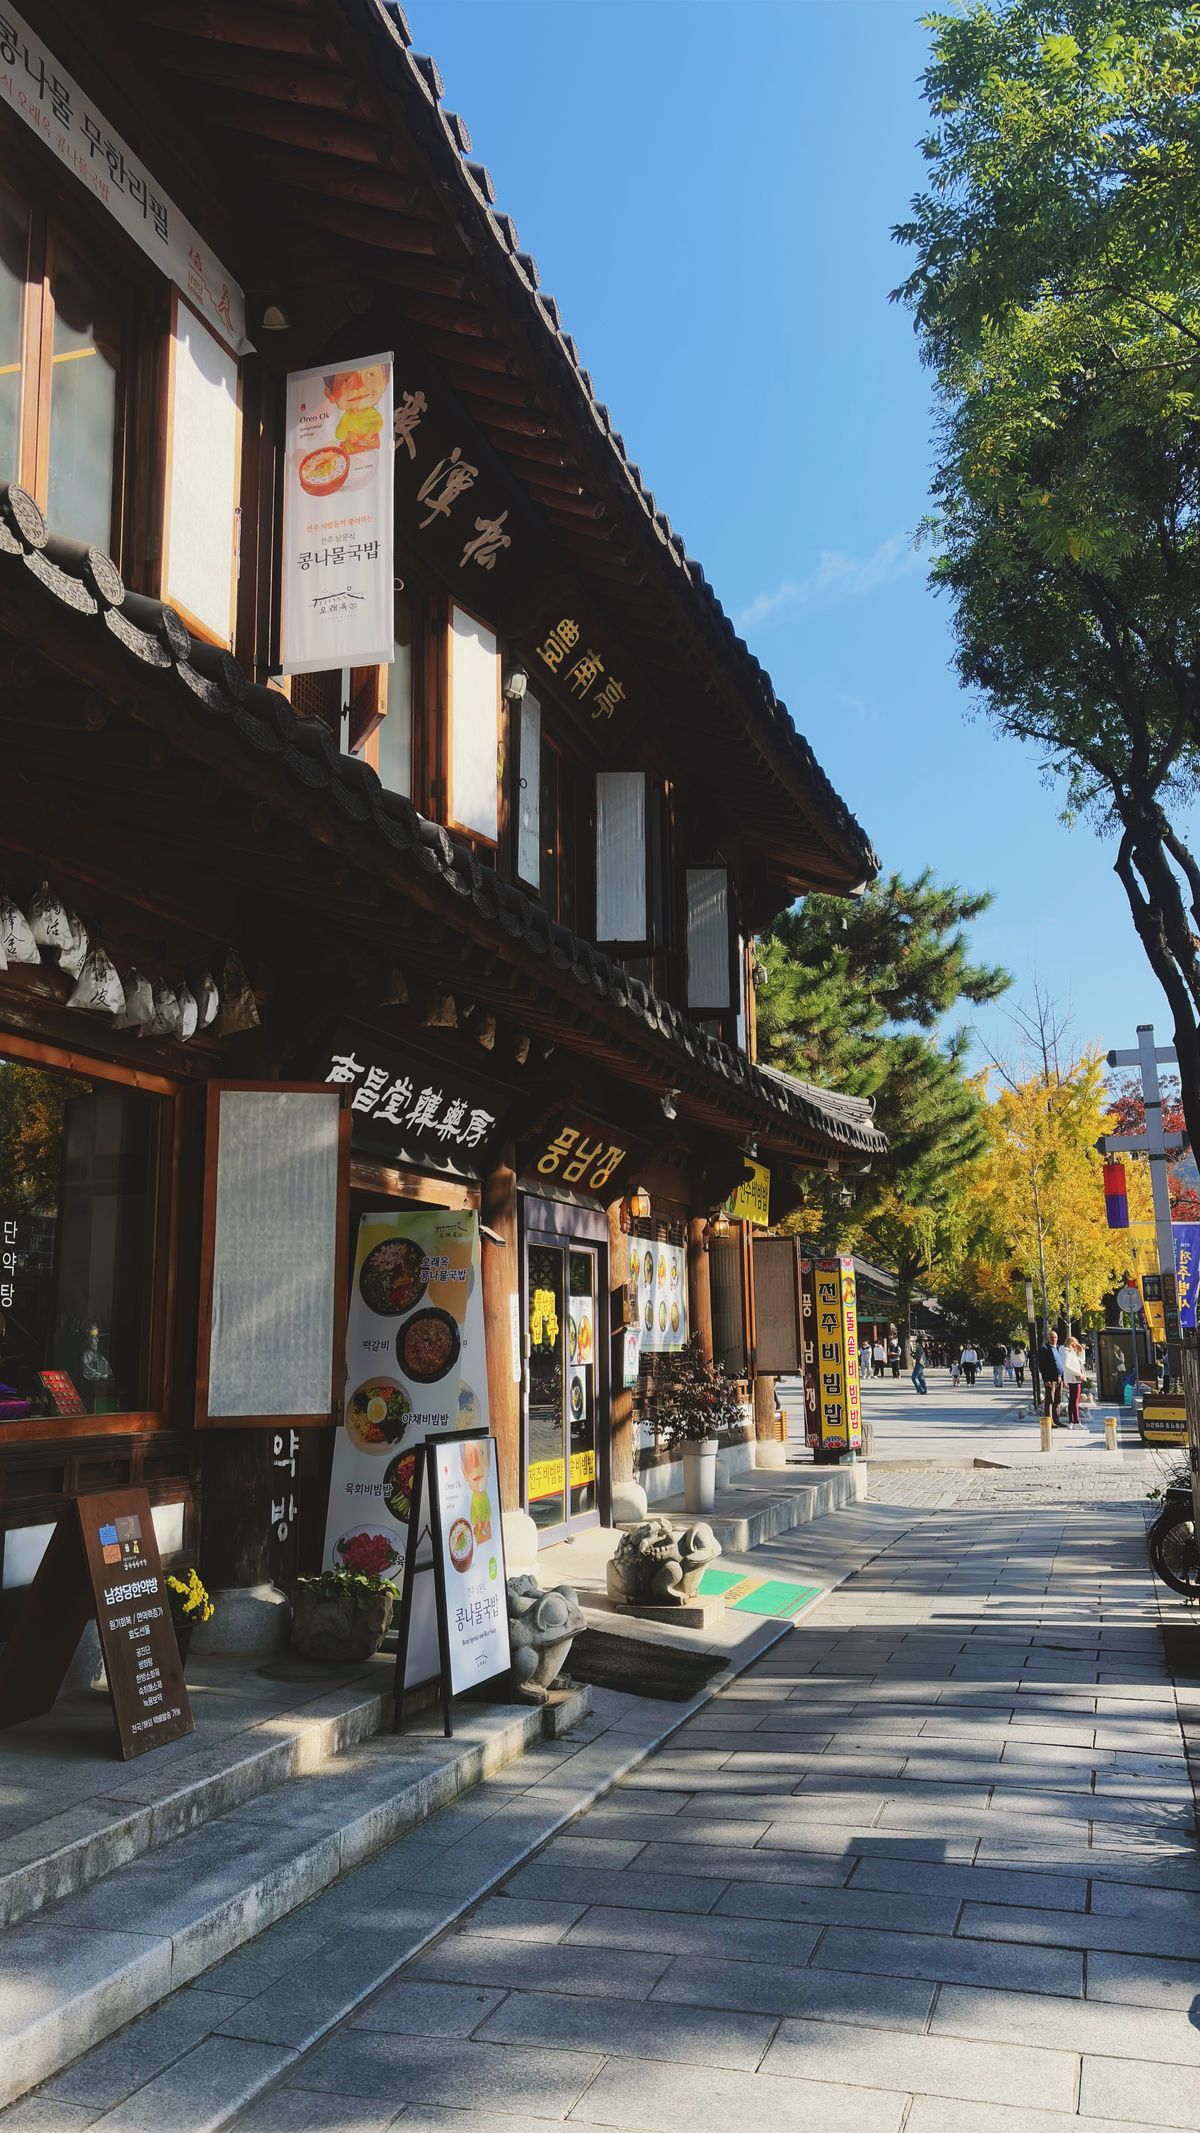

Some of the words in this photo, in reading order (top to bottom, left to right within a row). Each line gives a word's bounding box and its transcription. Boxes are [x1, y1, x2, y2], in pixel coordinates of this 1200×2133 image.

[0, 14, 73, 130] 콩나물
[80, 111, 168, 245] 무한리필
[298, 540, 380, 571] 콩나물국밥
[537, 1127, 626, 1189] 풍남정
[1, 1220, 18, 1308] 단약탕
[420, 1269, 468, 1284] 콩나물국밥
[421, 1256, 450, 1268] 오래옥
[362, 1340, 390, 1352] 떡갈비
[818, 1281, 845, 1428] 전주비빔밥
[846, 1310, 860, 1431] 돌솥비빔밥
[402, 1413, 450, 1427] 야채비빔밥
[345, 1482, 394, 1498] 육회비빔밥
[528, 1460, 564, 1491] 전주비빔밥
[104, 1577, 159, 1606] 남창당한약방
[455, 1594, 499, 1632] 콩나물국밥
[128, 1624, 151, 1640] 효도선물
[136, 1645, 151, 1658] 공진단
